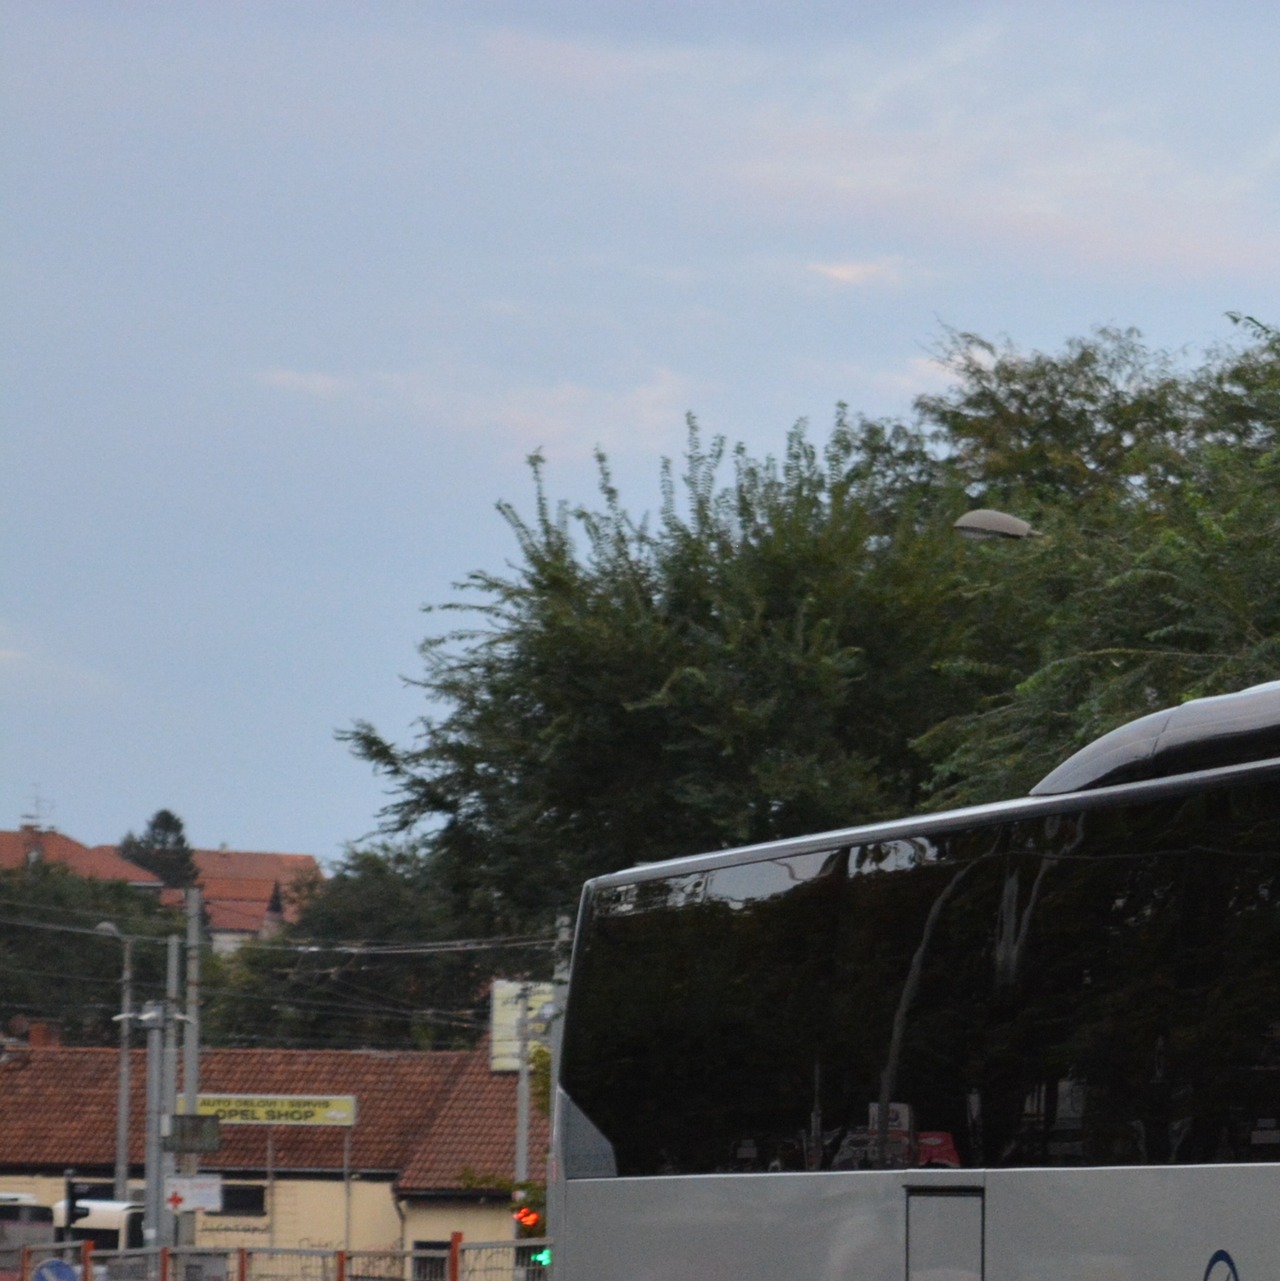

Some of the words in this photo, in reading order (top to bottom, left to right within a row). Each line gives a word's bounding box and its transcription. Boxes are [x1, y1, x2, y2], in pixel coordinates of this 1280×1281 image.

[200, 1099, 231, 1107] AUTO
[288, 1100, 330, 1109] SERVIS
[217, 1109, 260, 1121] OPEL
[265, 1109, 316, 1121] SHOP
